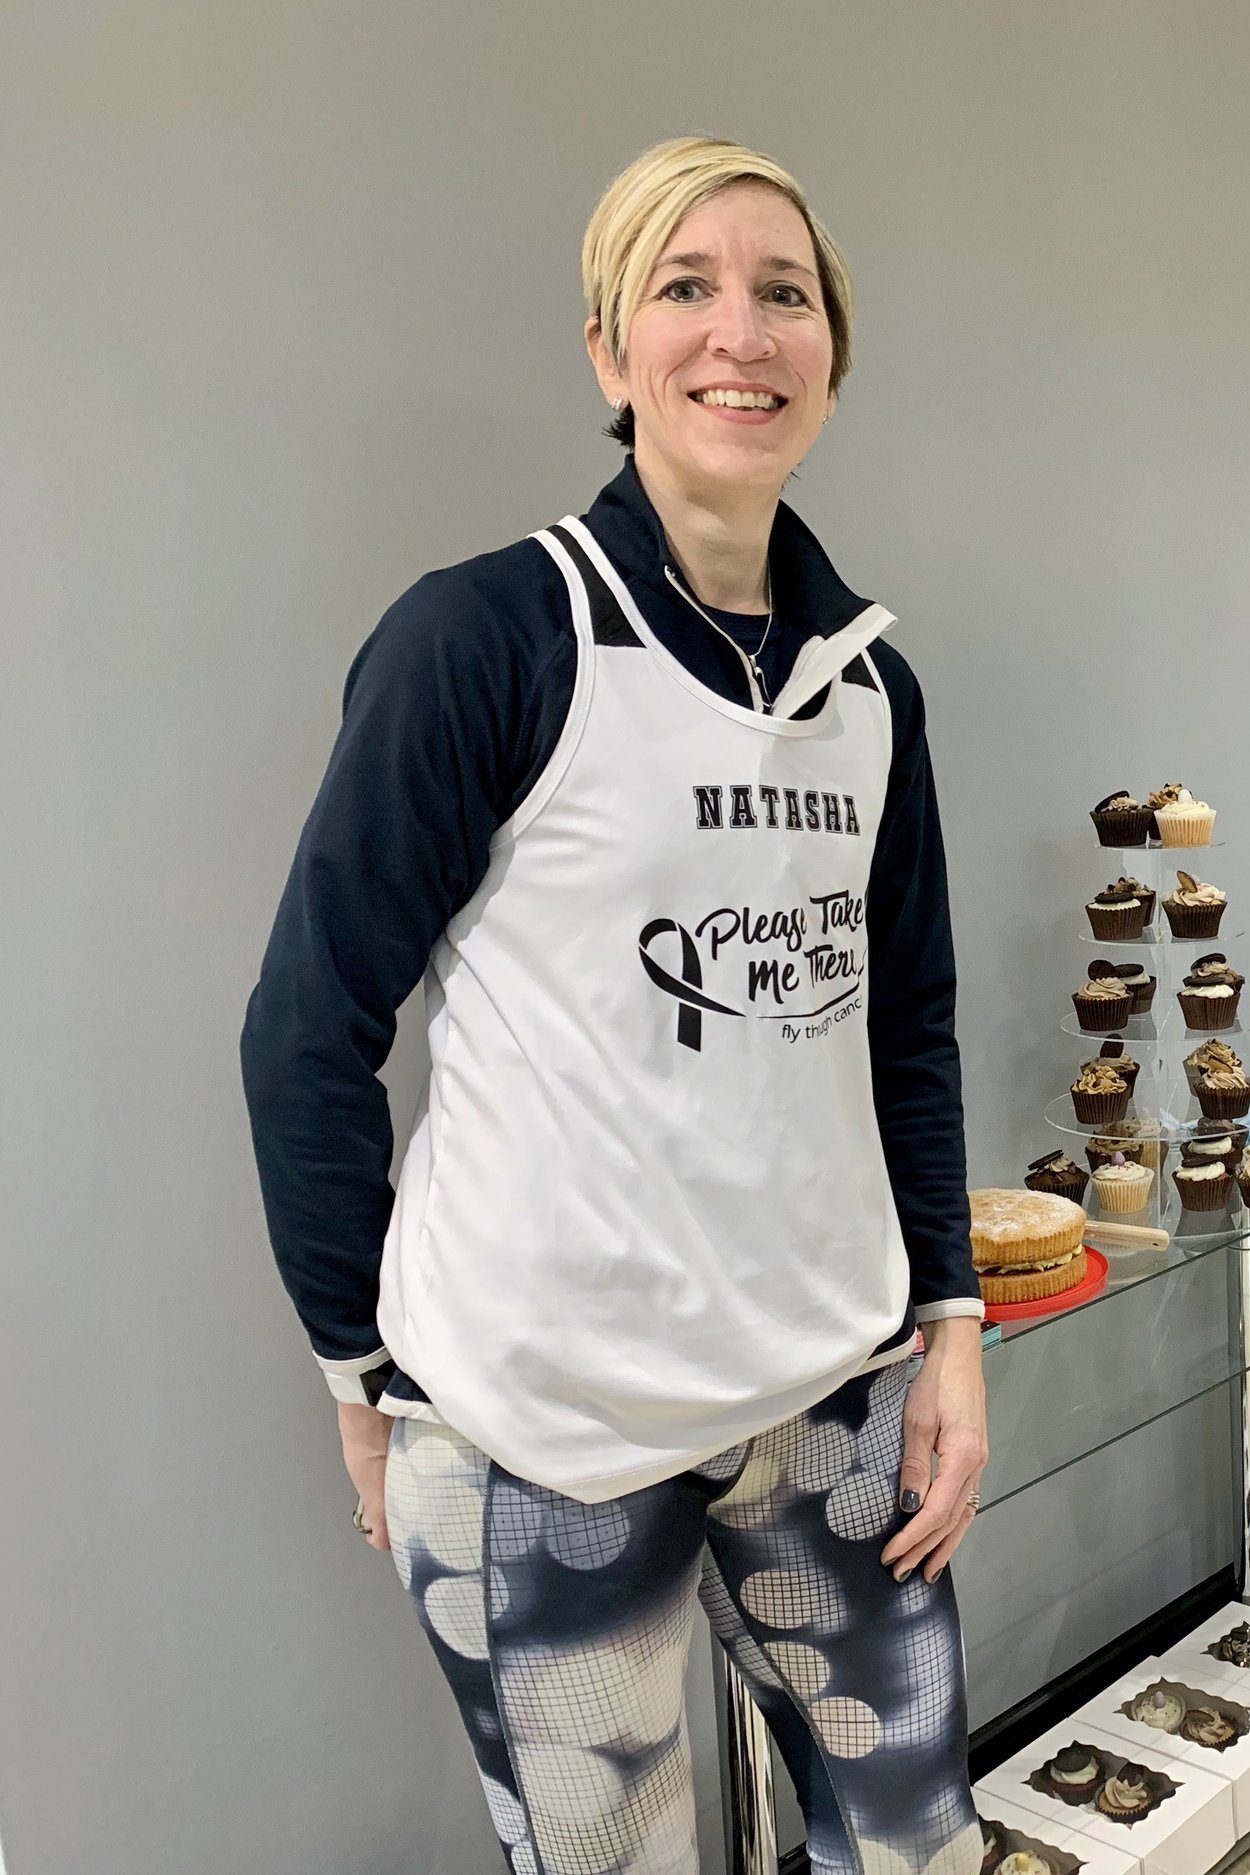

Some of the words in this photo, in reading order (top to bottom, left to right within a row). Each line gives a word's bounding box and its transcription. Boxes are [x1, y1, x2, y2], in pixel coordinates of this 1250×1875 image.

[692, 785, 861, 836] NATASHA
[809, 889, 864, 935] Take
[748, 959, 799, 1004] Me
[782, 1024, 801, 1043] fly
[834, 994, 863, 1022] canc
